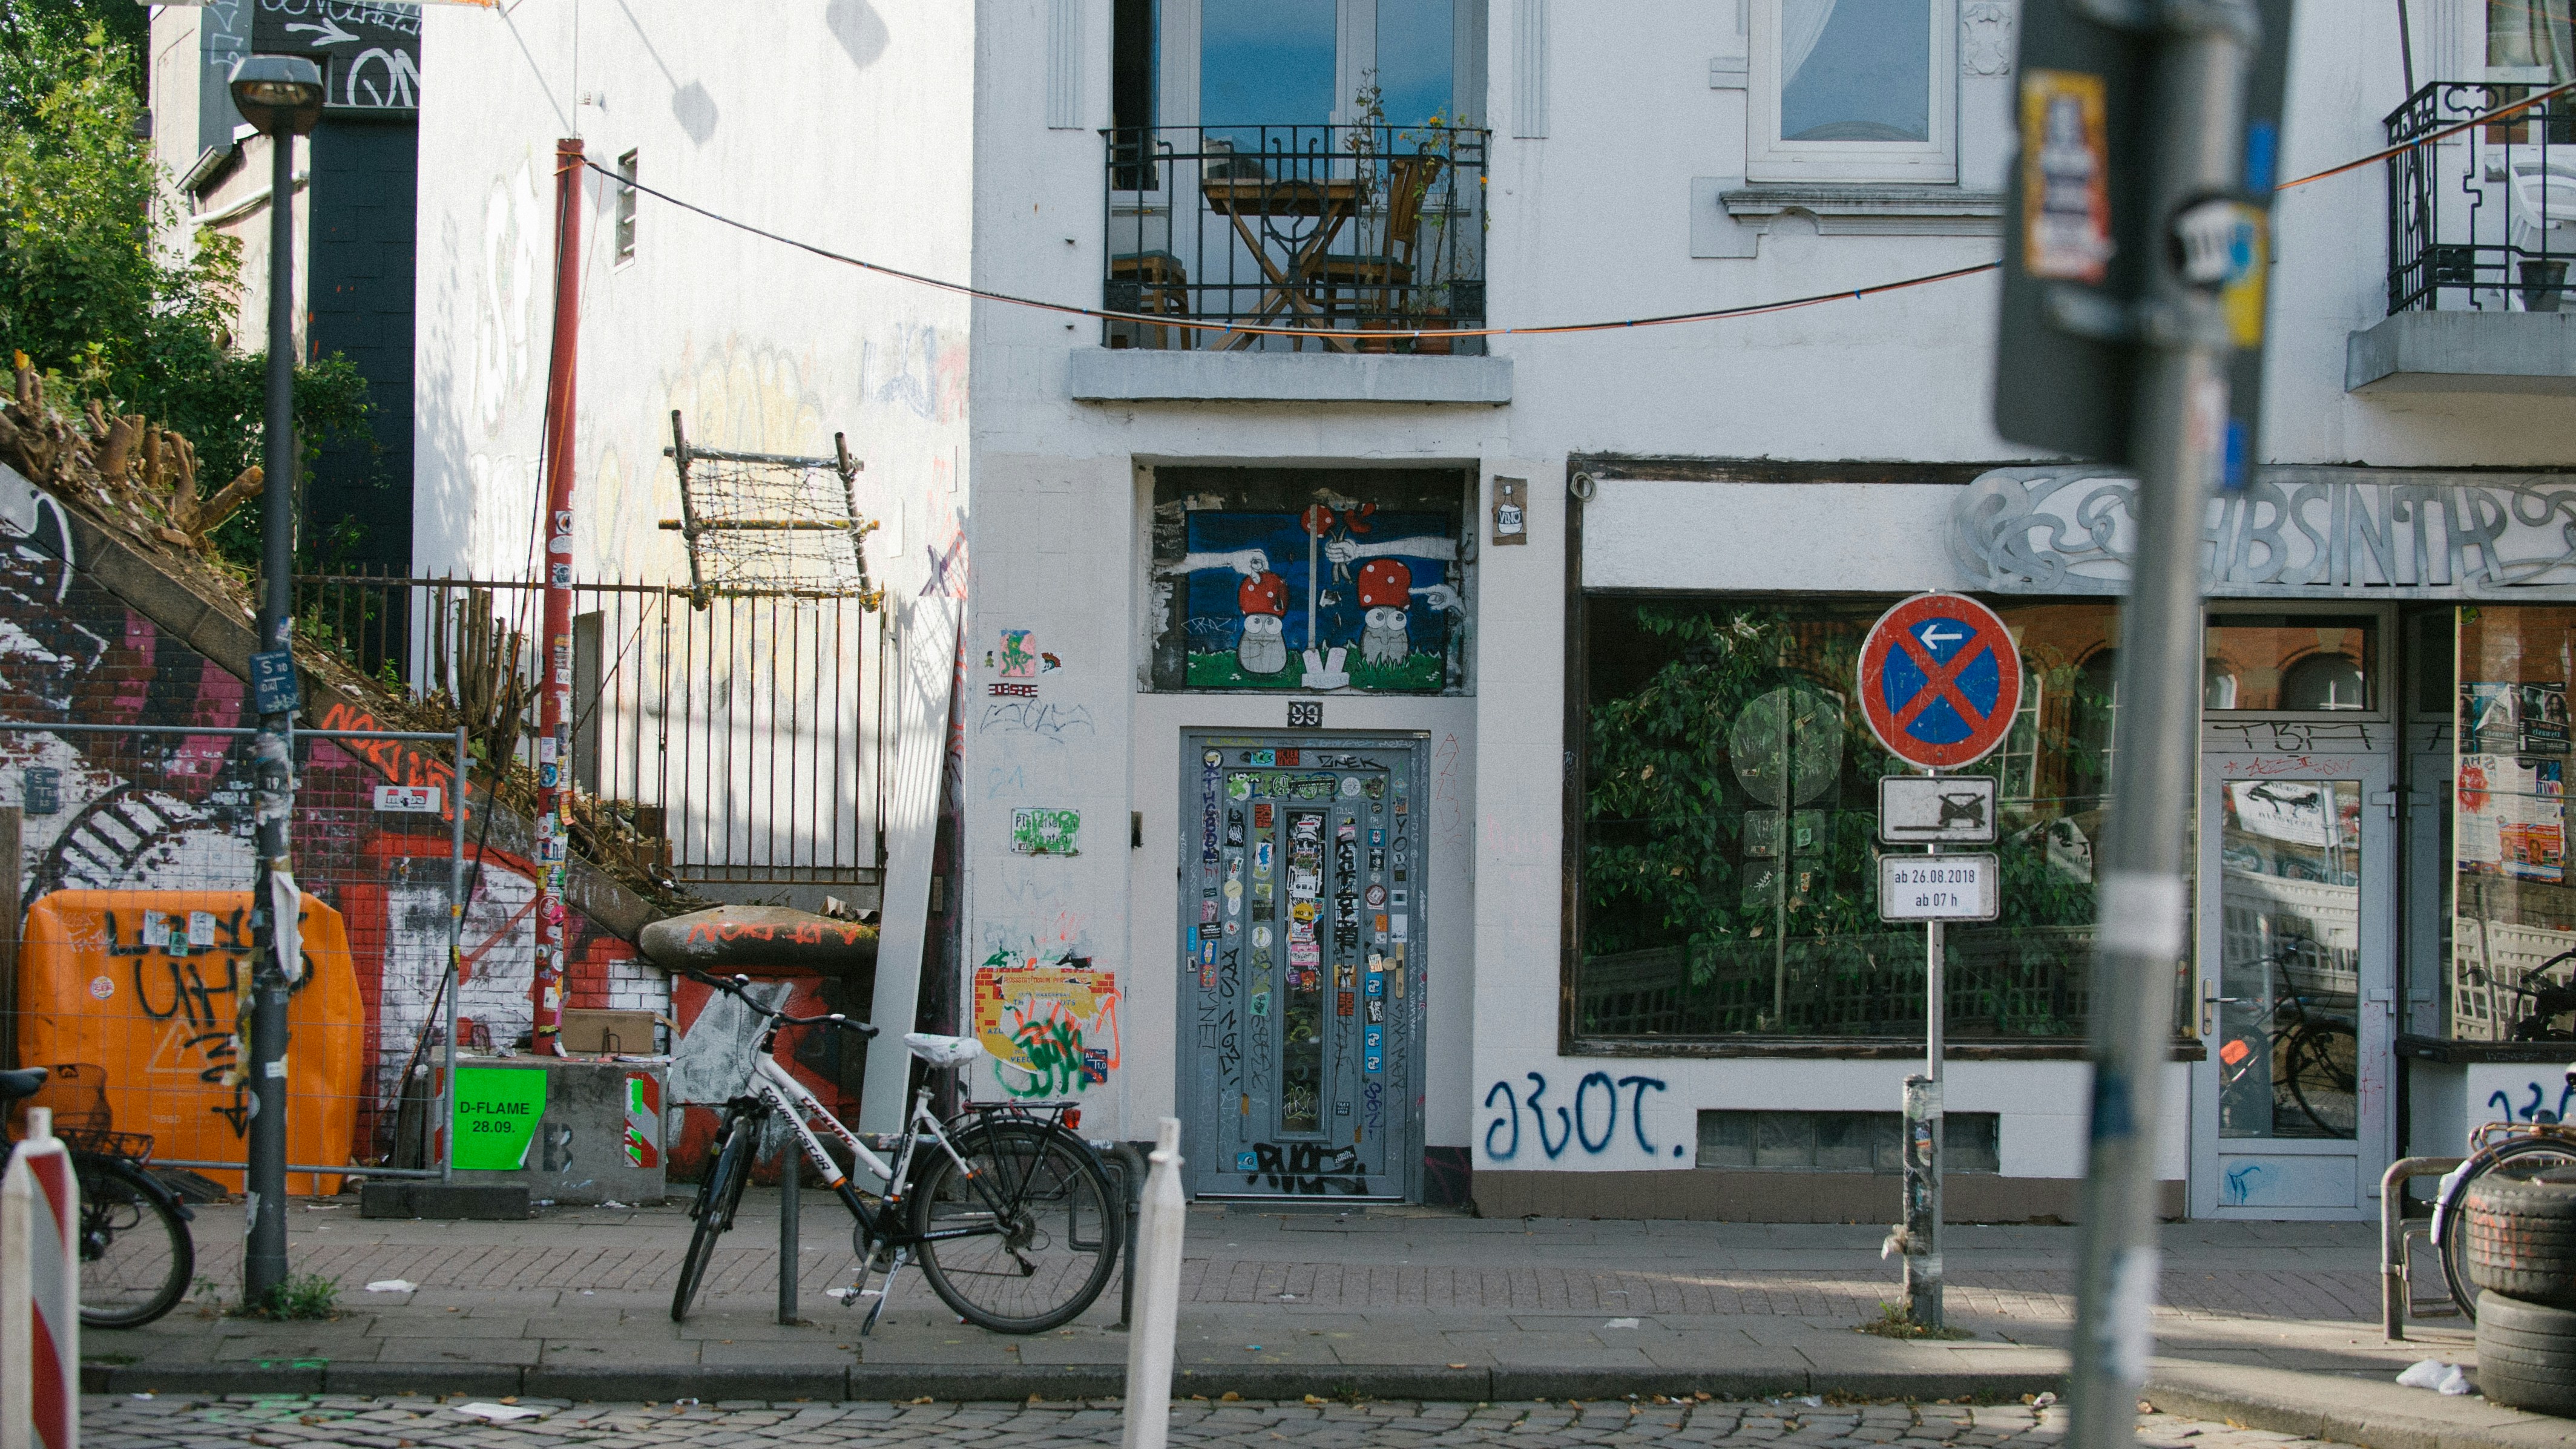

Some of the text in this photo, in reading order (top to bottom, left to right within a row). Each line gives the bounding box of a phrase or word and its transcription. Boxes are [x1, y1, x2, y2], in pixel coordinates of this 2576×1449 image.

[1498, 510, 1522, 525] VINO
[261, 660, 273, 674] S
[1290, 704, 1319, 725] 99
[1016, 815, 1076, 829] Platieren
[1023, 832, 1068, 843] vbotn
[1894, 870, 1975, 884] ab 26.08.2018
[1916, 893, 1957, 907] ab 07 h
[460, 1102, 530, 1116] D-FLAME
[473, 1120, 516, 1134] 28.09.
[761, 1085, 831, 1172] TOURINGSTAR
